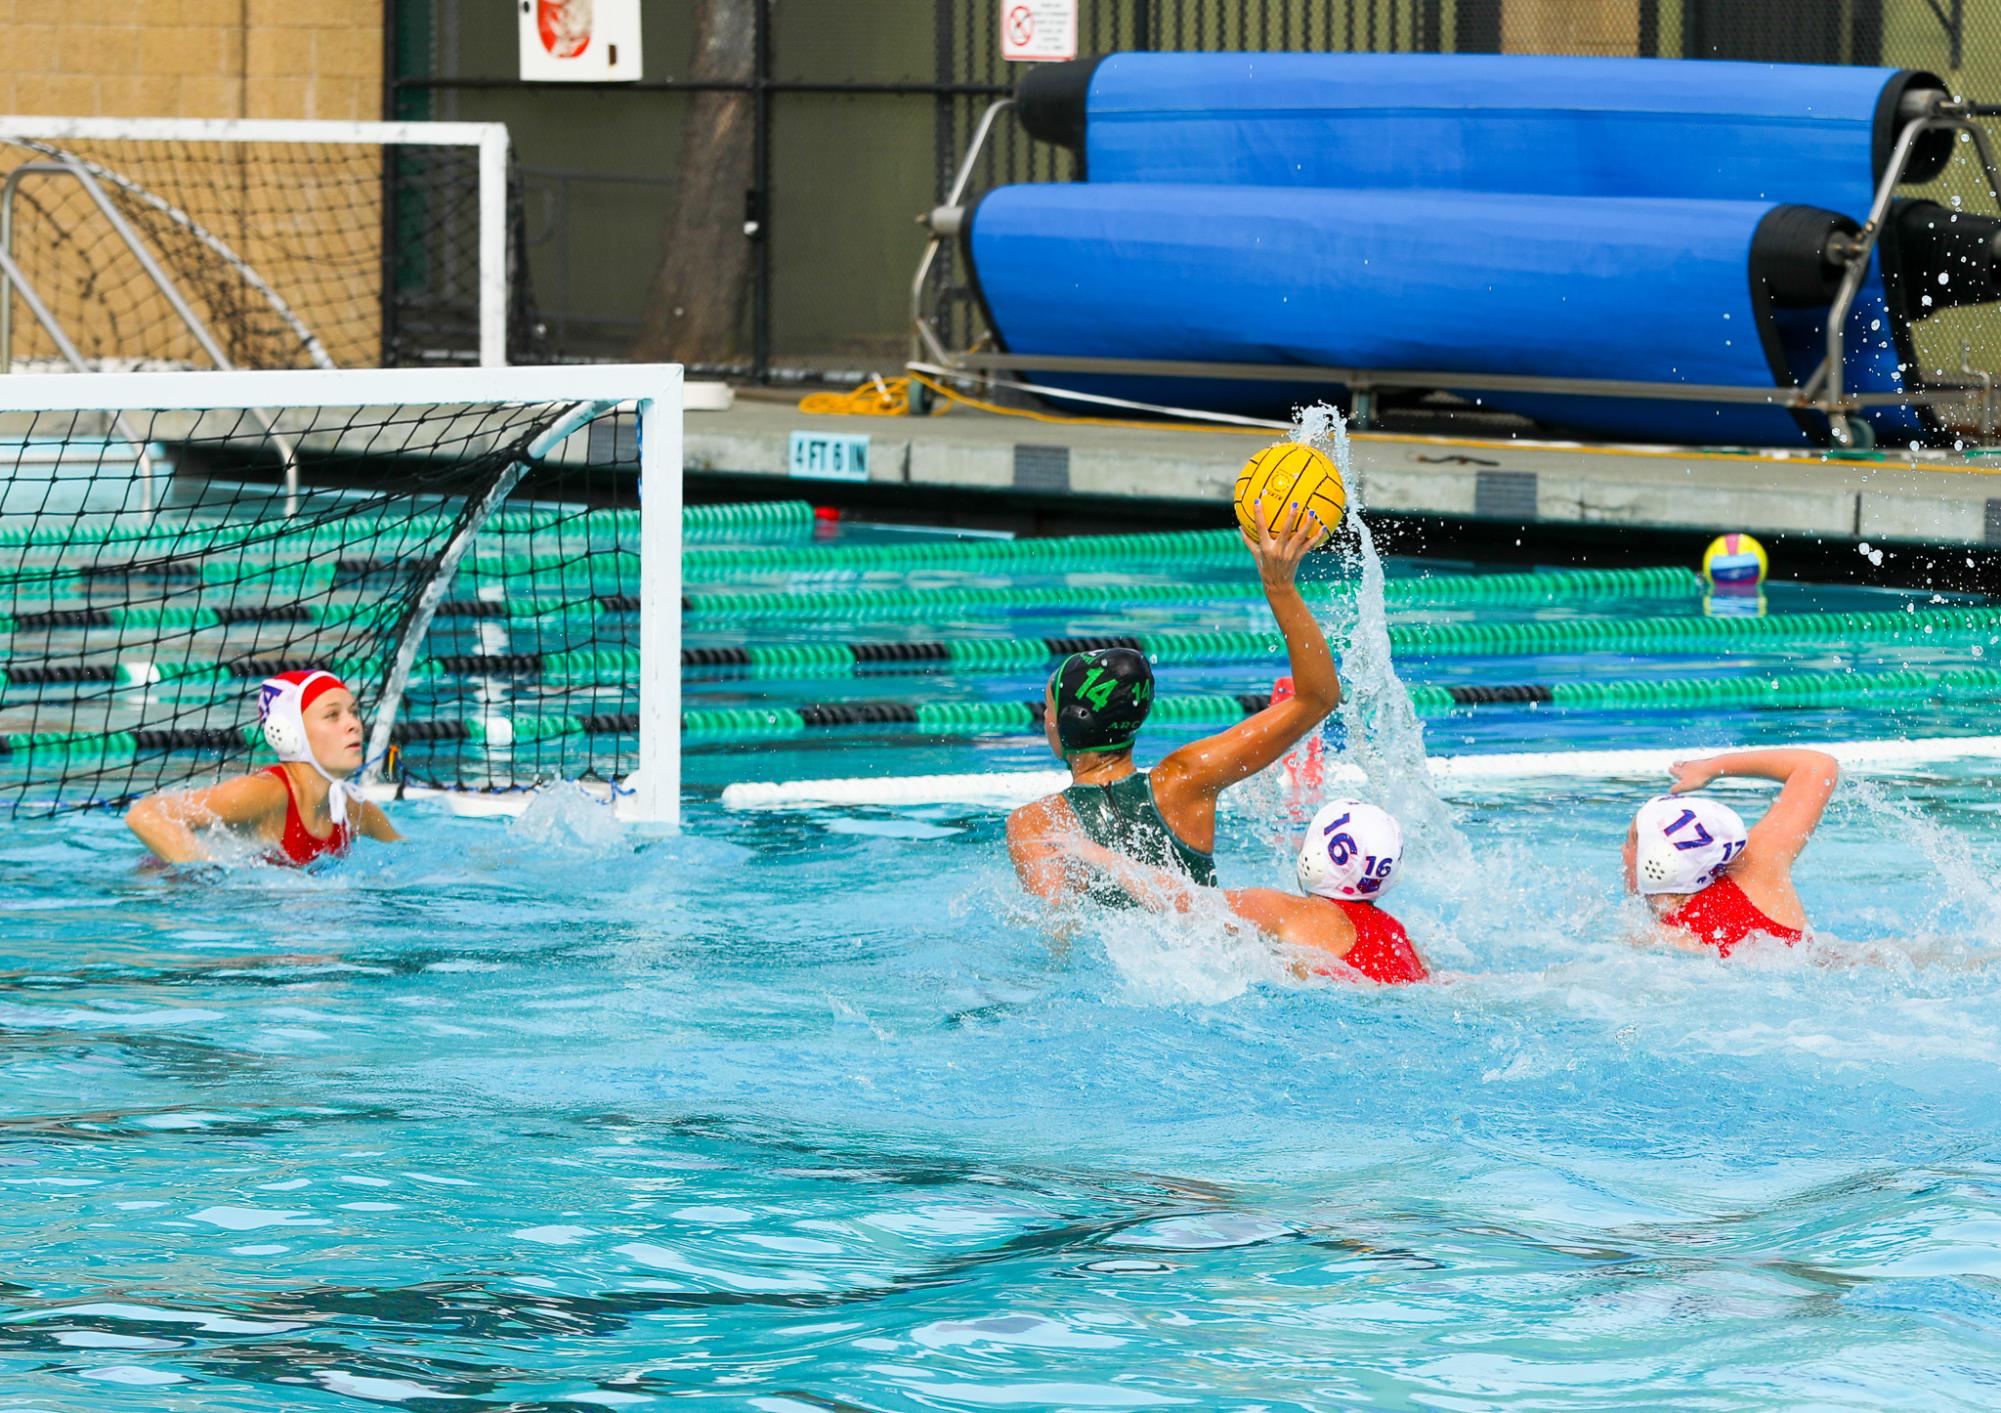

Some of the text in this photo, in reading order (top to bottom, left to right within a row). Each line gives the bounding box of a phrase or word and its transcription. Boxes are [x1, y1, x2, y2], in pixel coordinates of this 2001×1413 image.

[795, 439, 867, 473] 4 FT 6 IN
[1075, 667, 1118, 712] 14
[1131, 679, 1151, 704] 14
[1324, 812, 1358, 865] 16
[1664, 809, 1714, 851] 17
[1365, 856, 1393, 877] 16
[1722, 840, 1746, 862] 17
